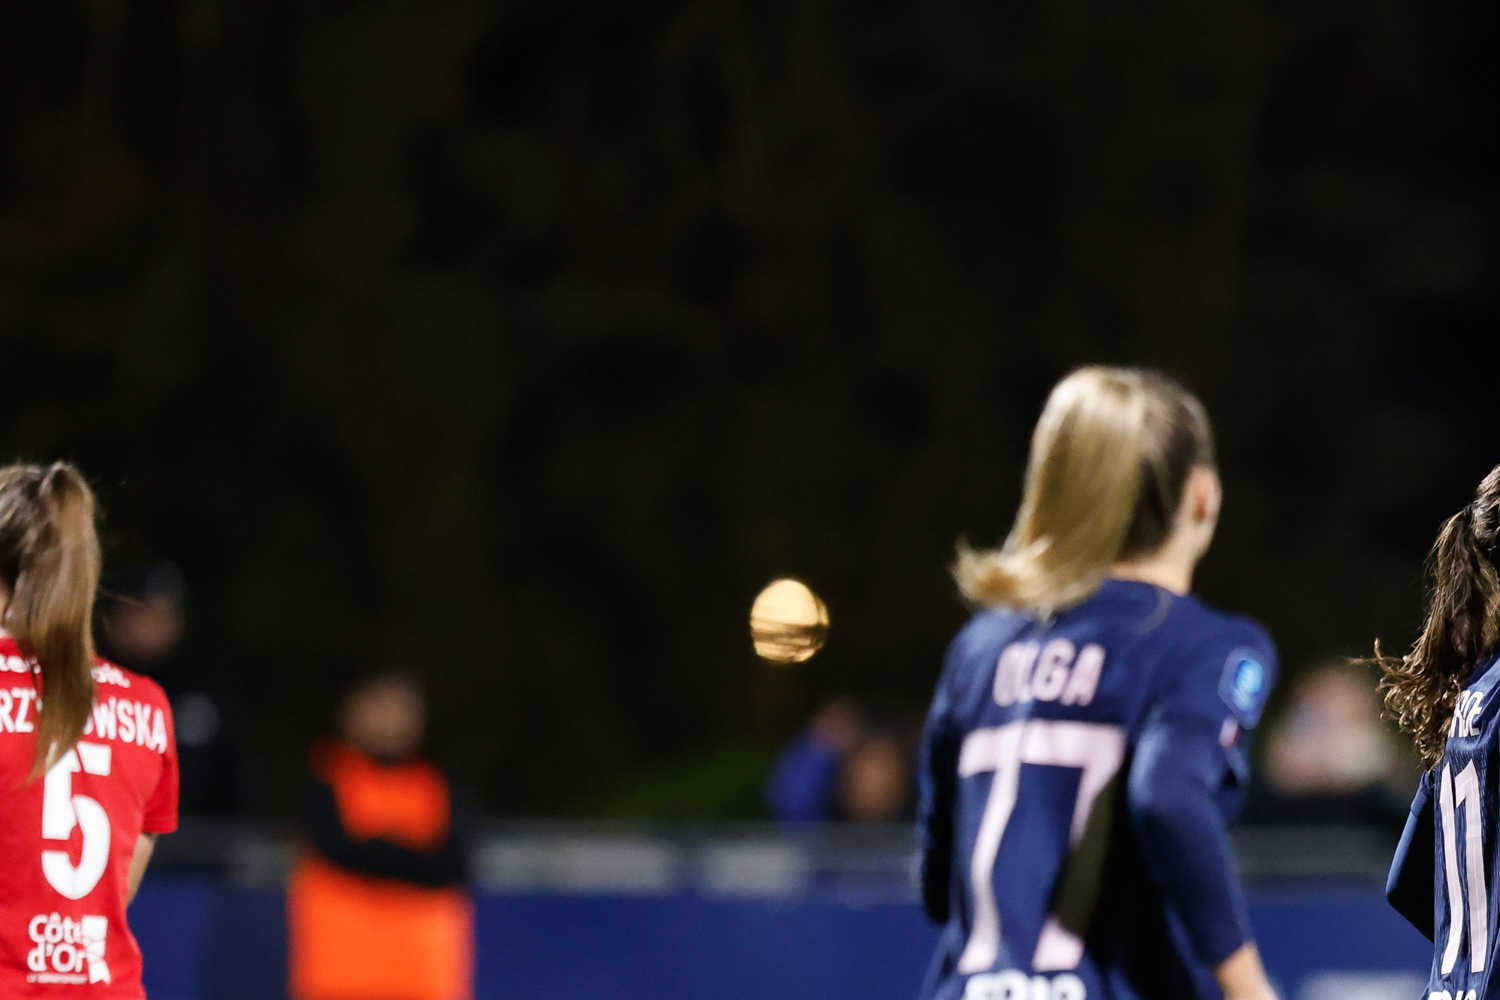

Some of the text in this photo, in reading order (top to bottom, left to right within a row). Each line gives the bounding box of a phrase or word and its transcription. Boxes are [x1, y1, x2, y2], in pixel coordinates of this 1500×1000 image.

[42, 743, 111, 900] 5
[957, 717, 1127, 975] 77
[1439, 758, 1488, 975] 11
